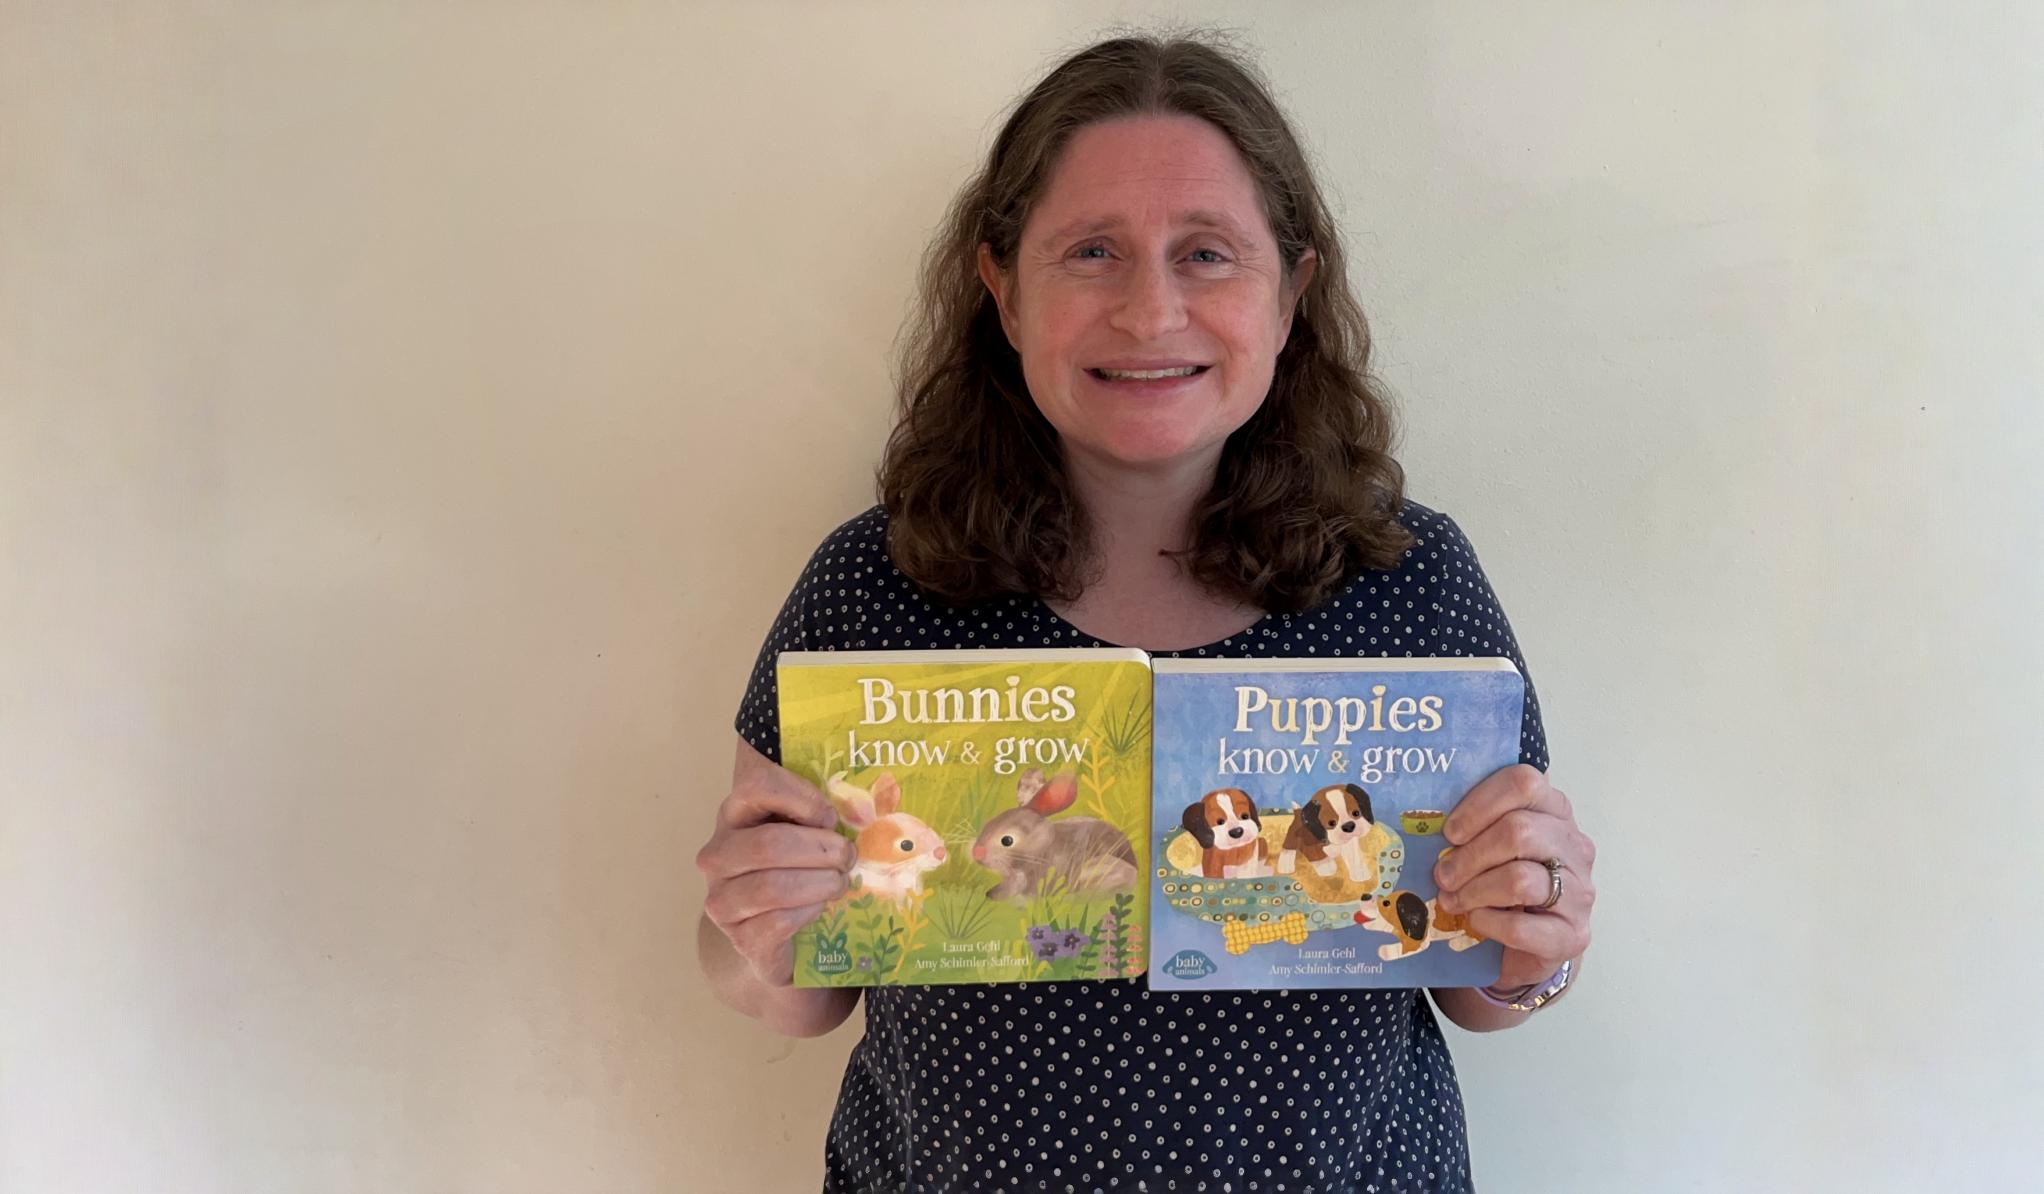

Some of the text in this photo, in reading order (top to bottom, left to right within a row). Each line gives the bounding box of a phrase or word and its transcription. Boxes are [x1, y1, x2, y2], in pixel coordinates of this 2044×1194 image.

[857, 675, 1076, 725] Bunnies
[1233, 685, 1443, 745] Puppies
[848, 730, 1089, 775] know & grow
[1217, 737, 1457, 784] know & grow
[943, 941, 974, 952] Laura
[1298, 947, 1356, 959] Laura Gehl
[818, 950, 848, 967] baby
[914, 959, 938, 972] Amy
[1175, 954, 1206, 970] baby
[1270, 962, 1383, 978] Amy Schimler-Safford
